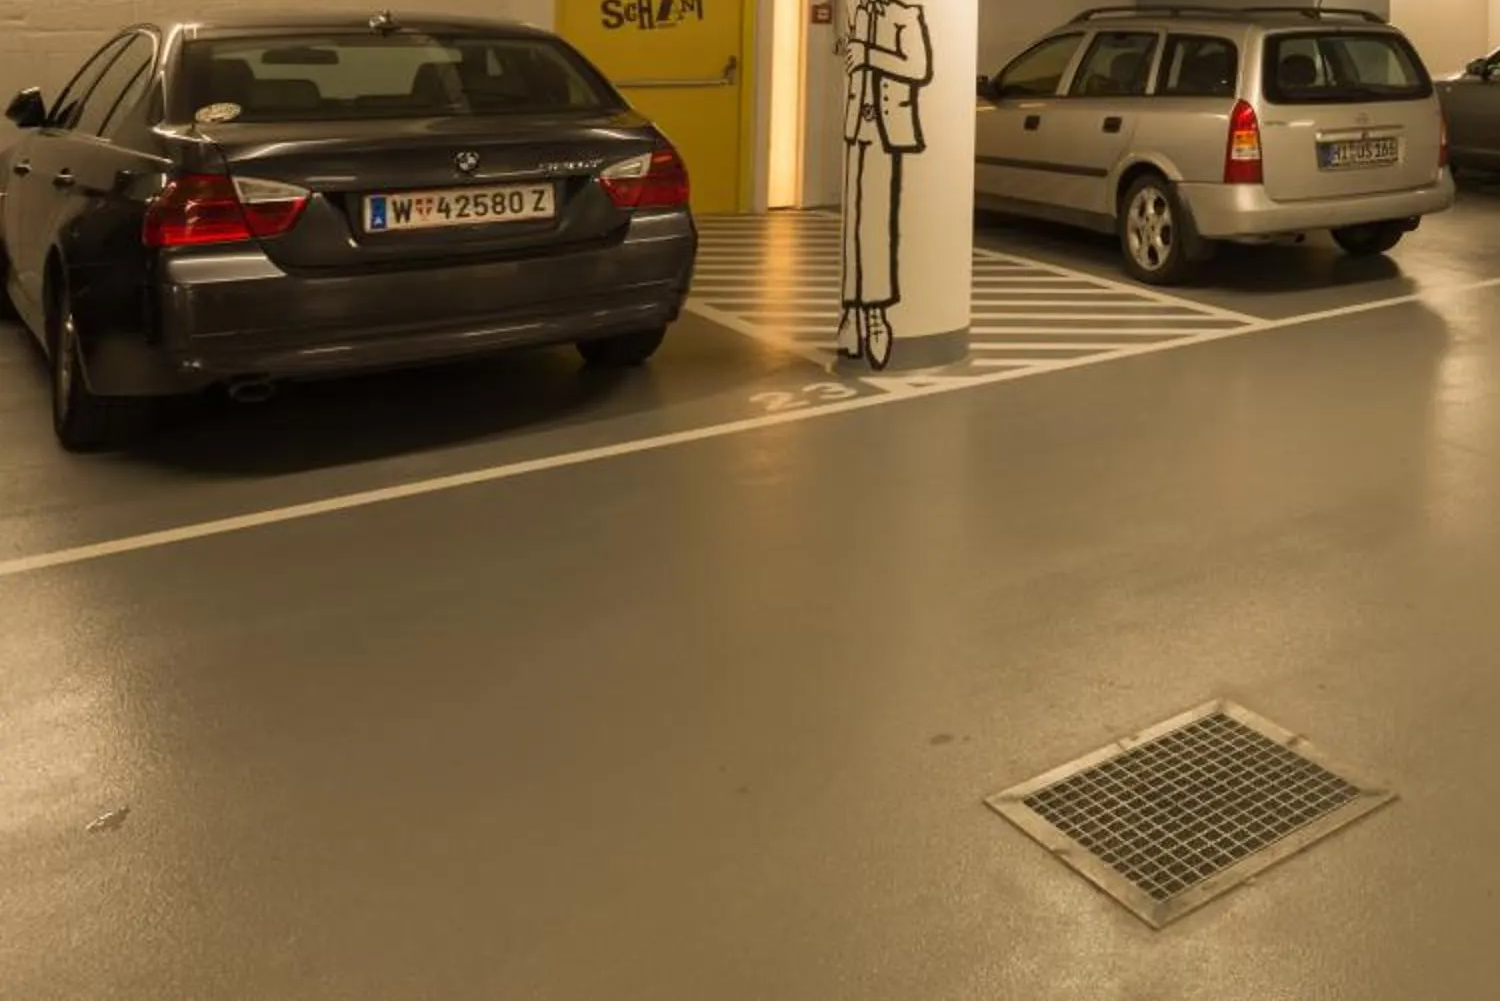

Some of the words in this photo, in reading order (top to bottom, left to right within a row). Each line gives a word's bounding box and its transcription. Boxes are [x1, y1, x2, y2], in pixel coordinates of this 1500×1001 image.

[391, 200, 413, 224] W
[436, 191, 524, 221] 42580
[531, 189, 546, 212] Z
[749, 382, 858, 412] 23
